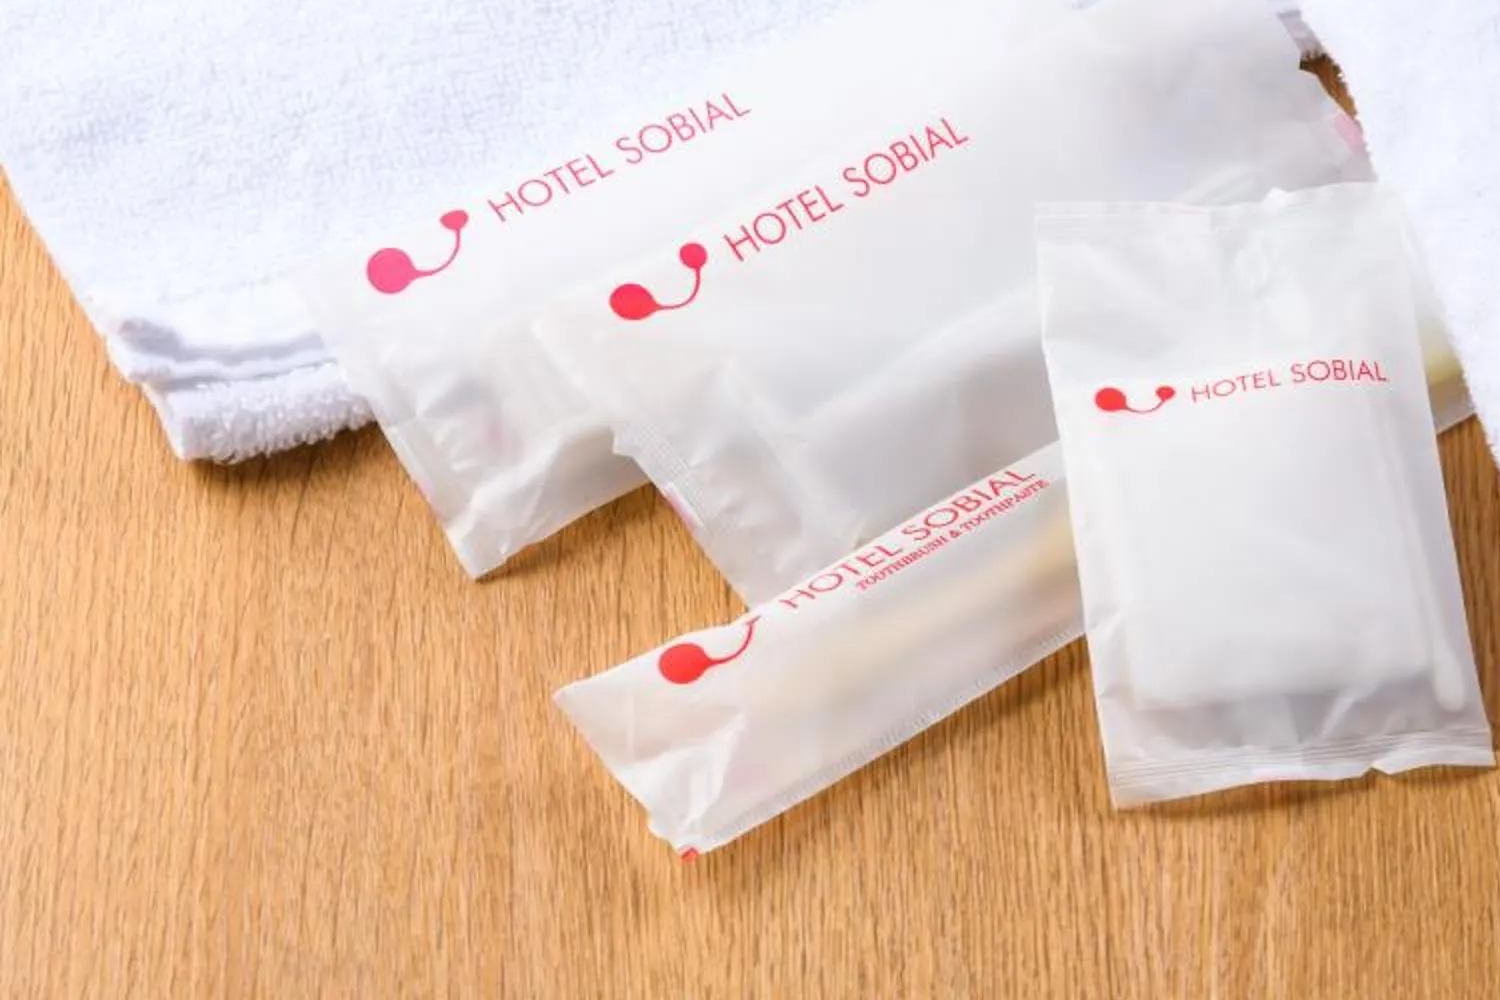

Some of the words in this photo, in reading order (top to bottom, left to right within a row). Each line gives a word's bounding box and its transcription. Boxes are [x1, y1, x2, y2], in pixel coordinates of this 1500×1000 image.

[487, 153, 615, 221] HOTEL
[616, 93, 751, 164] SOBIAL
[724, 184, 844, 262] HOTEL
[842, 118, 970, 198] SOBIAL
[1191, 369, 1282, 402] HOTEL
[1291, 359, 1388, 384] SOBIAL
[779, 544, 903, 609] HOTEL
[902, 470, 1036, 541] SOBIAL
[856, 535, 948, 590] TOOTHBRUSH
[948, 528, 962, 540] &
[960, 479, 1049, 532] TOOTHPASTE
